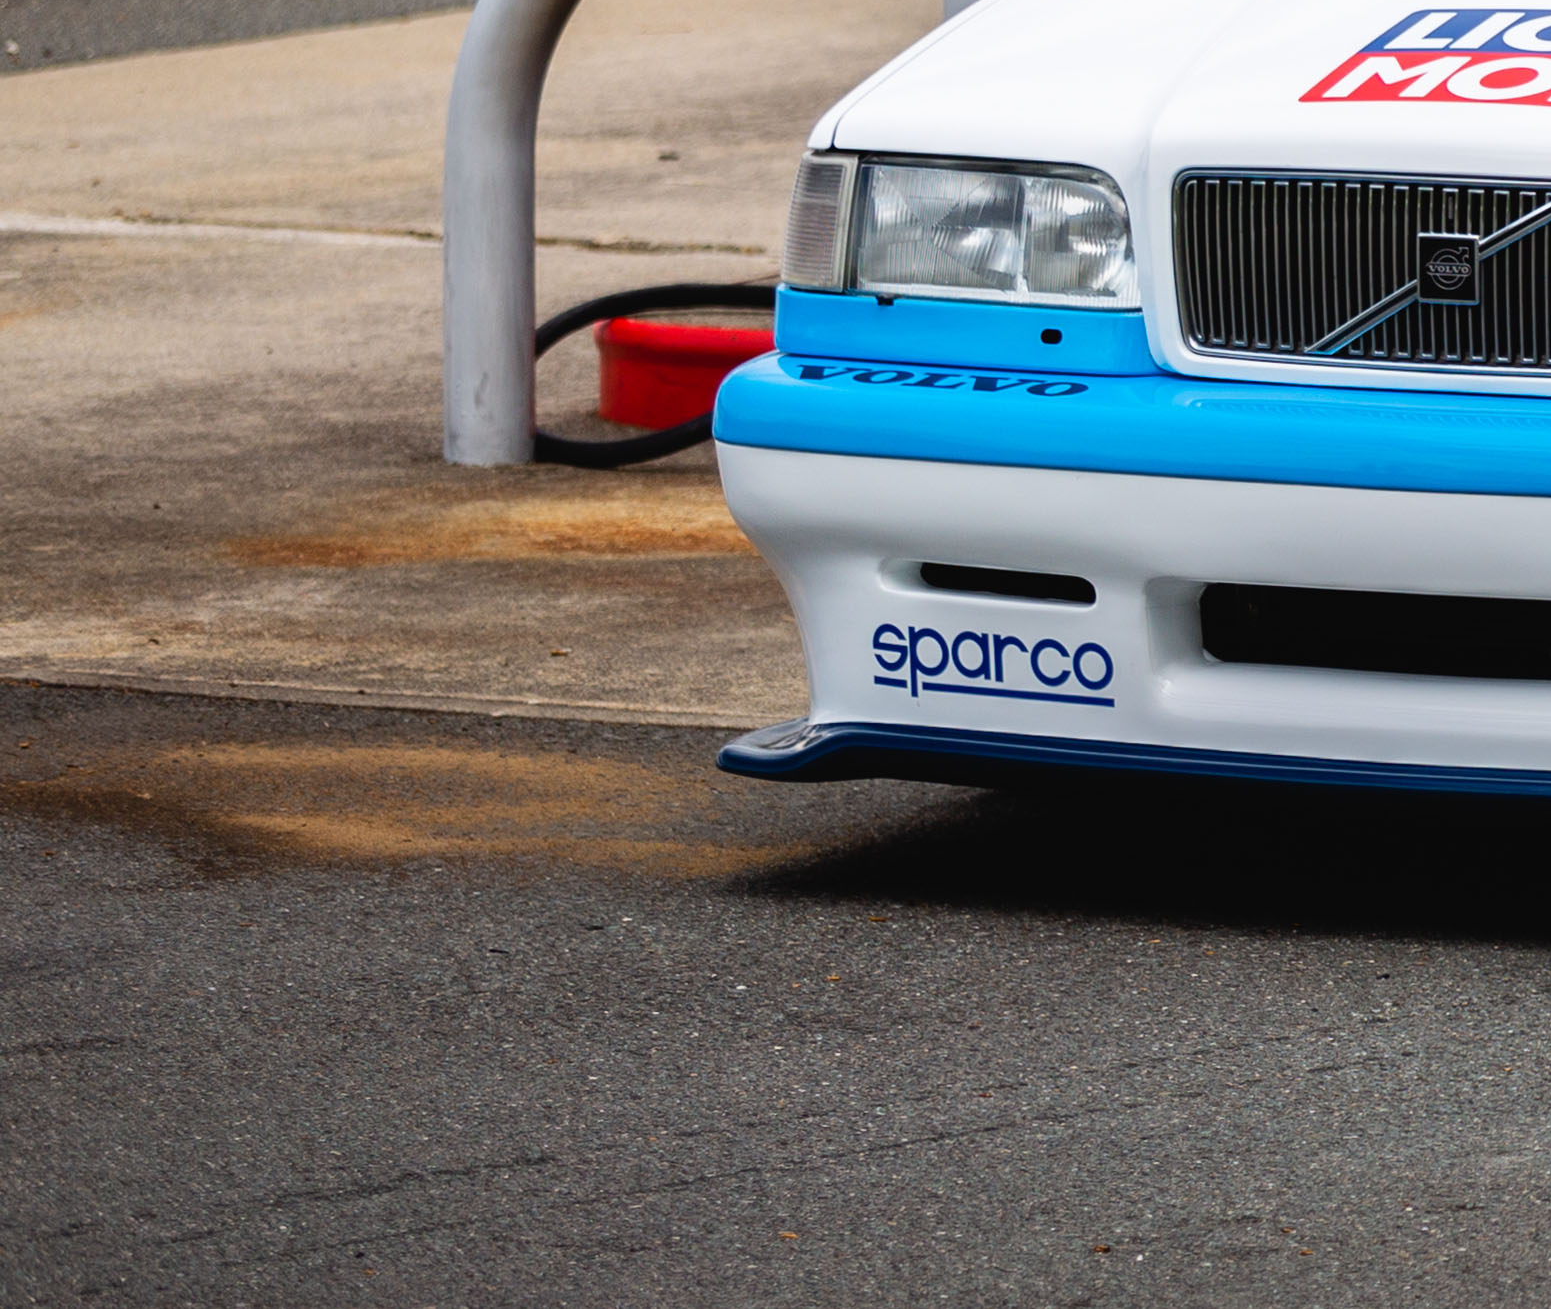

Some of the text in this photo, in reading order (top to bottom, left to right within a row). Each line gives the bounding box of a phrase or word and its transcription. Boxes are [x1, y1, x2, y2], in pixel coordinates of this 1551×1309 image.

[1428, 264, 1470, 274] VOLVO
[796, 364, 1090, 397] VOLVO
[873, 623, 1114, 701] sparco
